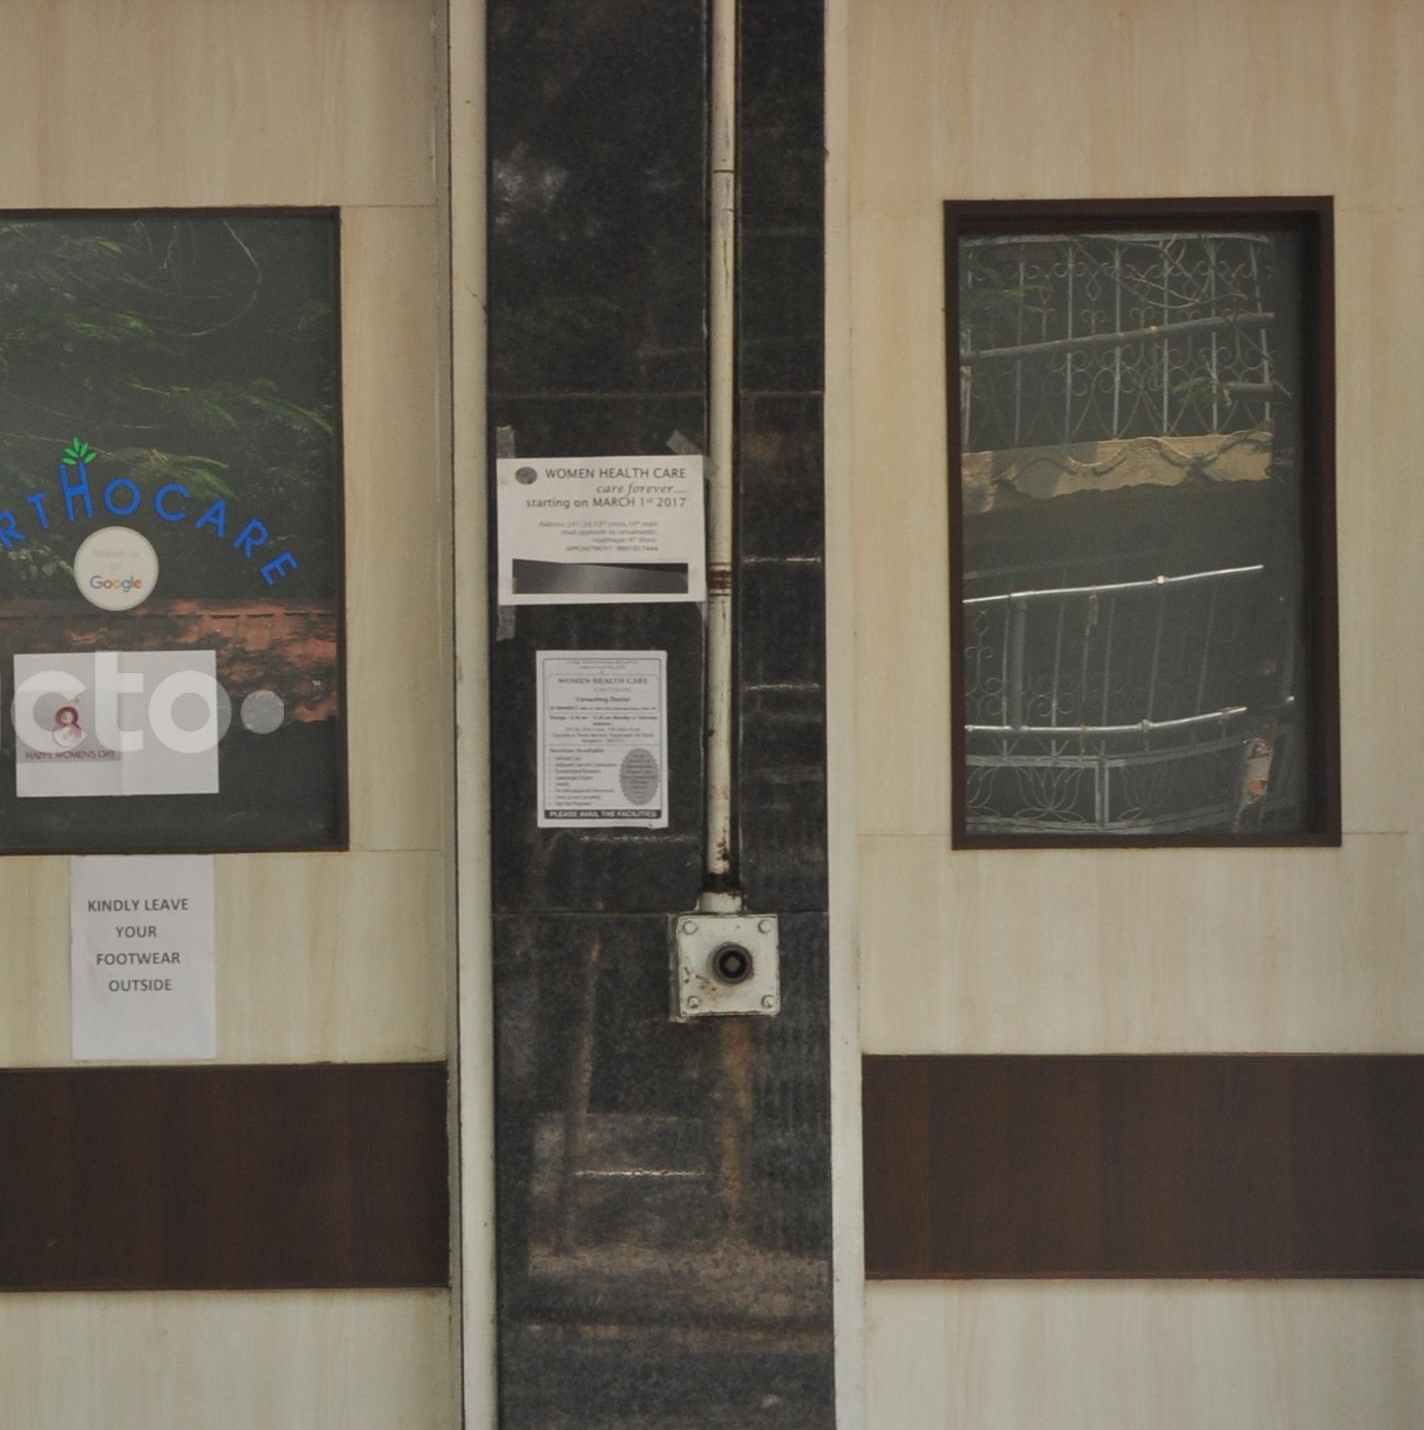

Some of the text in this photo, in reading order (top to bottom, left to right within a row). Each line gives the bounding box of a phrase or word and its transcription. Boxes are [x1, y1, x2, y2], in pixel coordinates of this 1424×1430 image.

[544, 467, 687, 479] WOMEN HEALTH CARE
[525, 497, 571, 510] starting
[574, 499, 589, 508] on
[592, 497, 636, 507] MARCH
[656, 497, 687, 508] 2017
[89, 574, 143, 593] Google
[87, 898, 190, 912] KINDLY LEAVE
[115, 925, 158, 939] YOUR
[96, 951, 182, 966] FOOTWEAR
[108, 978, 174, 993] OUTSIDE
